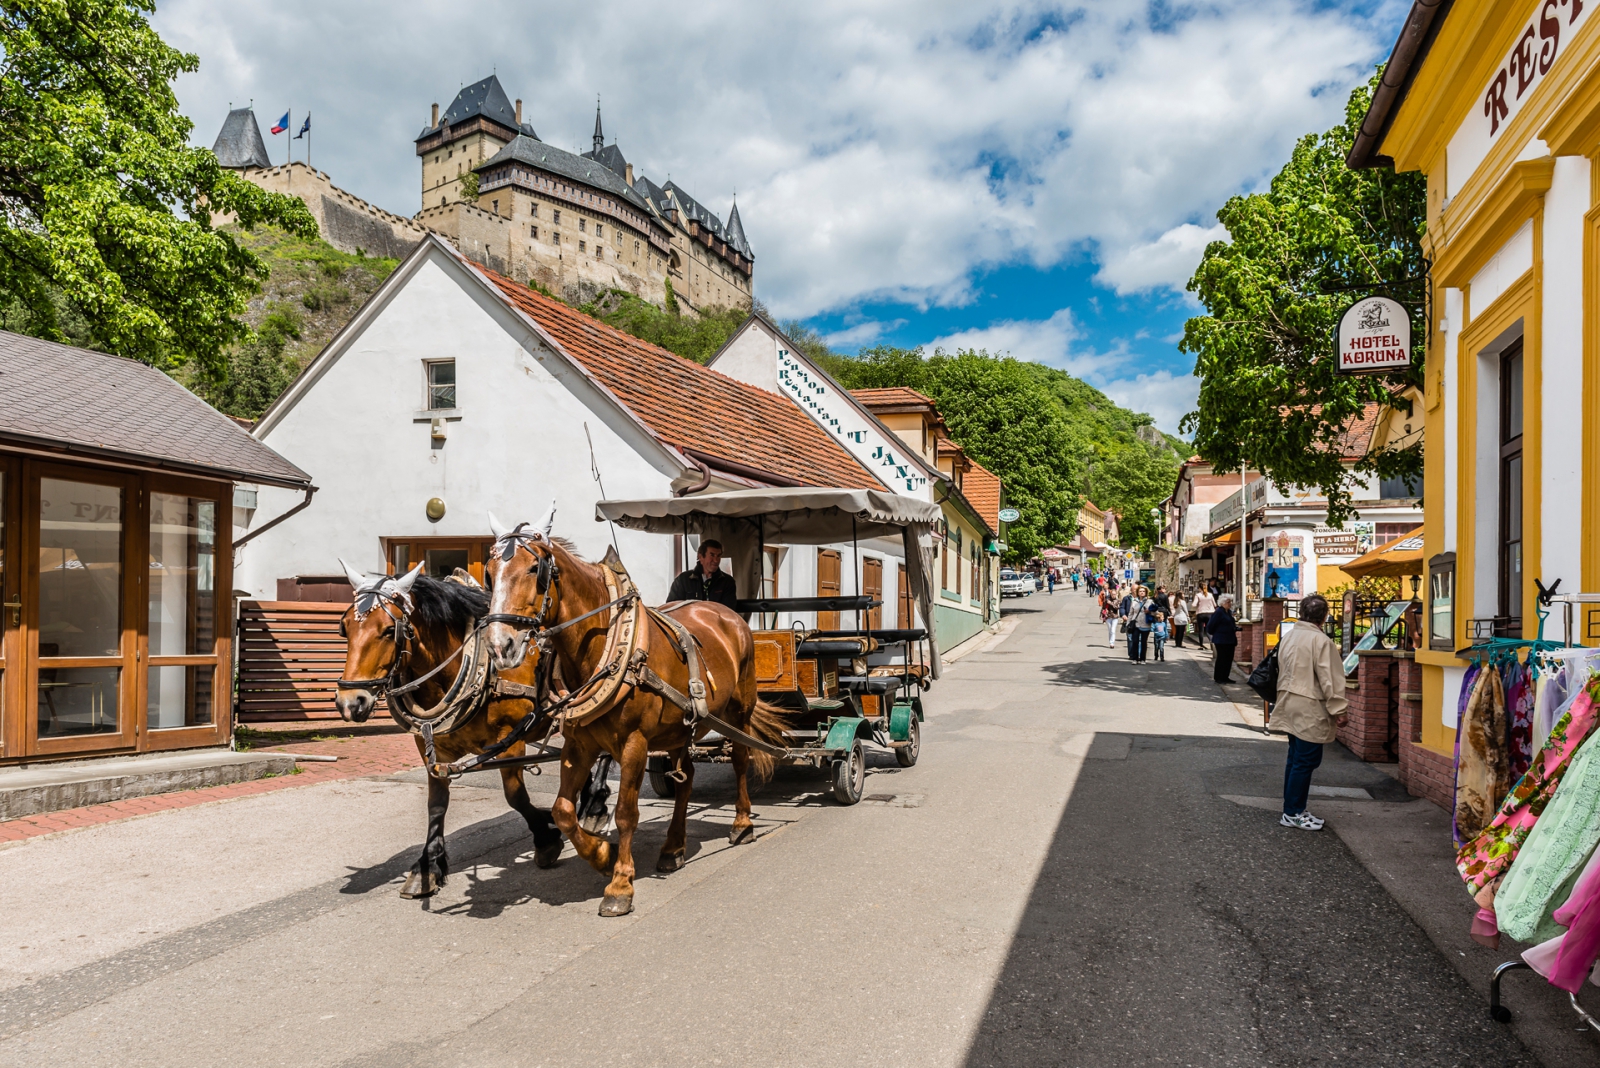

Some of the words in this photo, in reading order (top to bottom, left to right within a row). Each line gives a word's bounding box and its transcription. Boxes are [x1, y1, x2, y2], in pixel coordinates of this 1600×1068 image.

[1343, 349, 1406, 365] KORUNA
[1349, 335, 1400, 349] HOTEL
[778, 350, 825, 394] Pension
[779, 370, 843, 434] Restaurant
